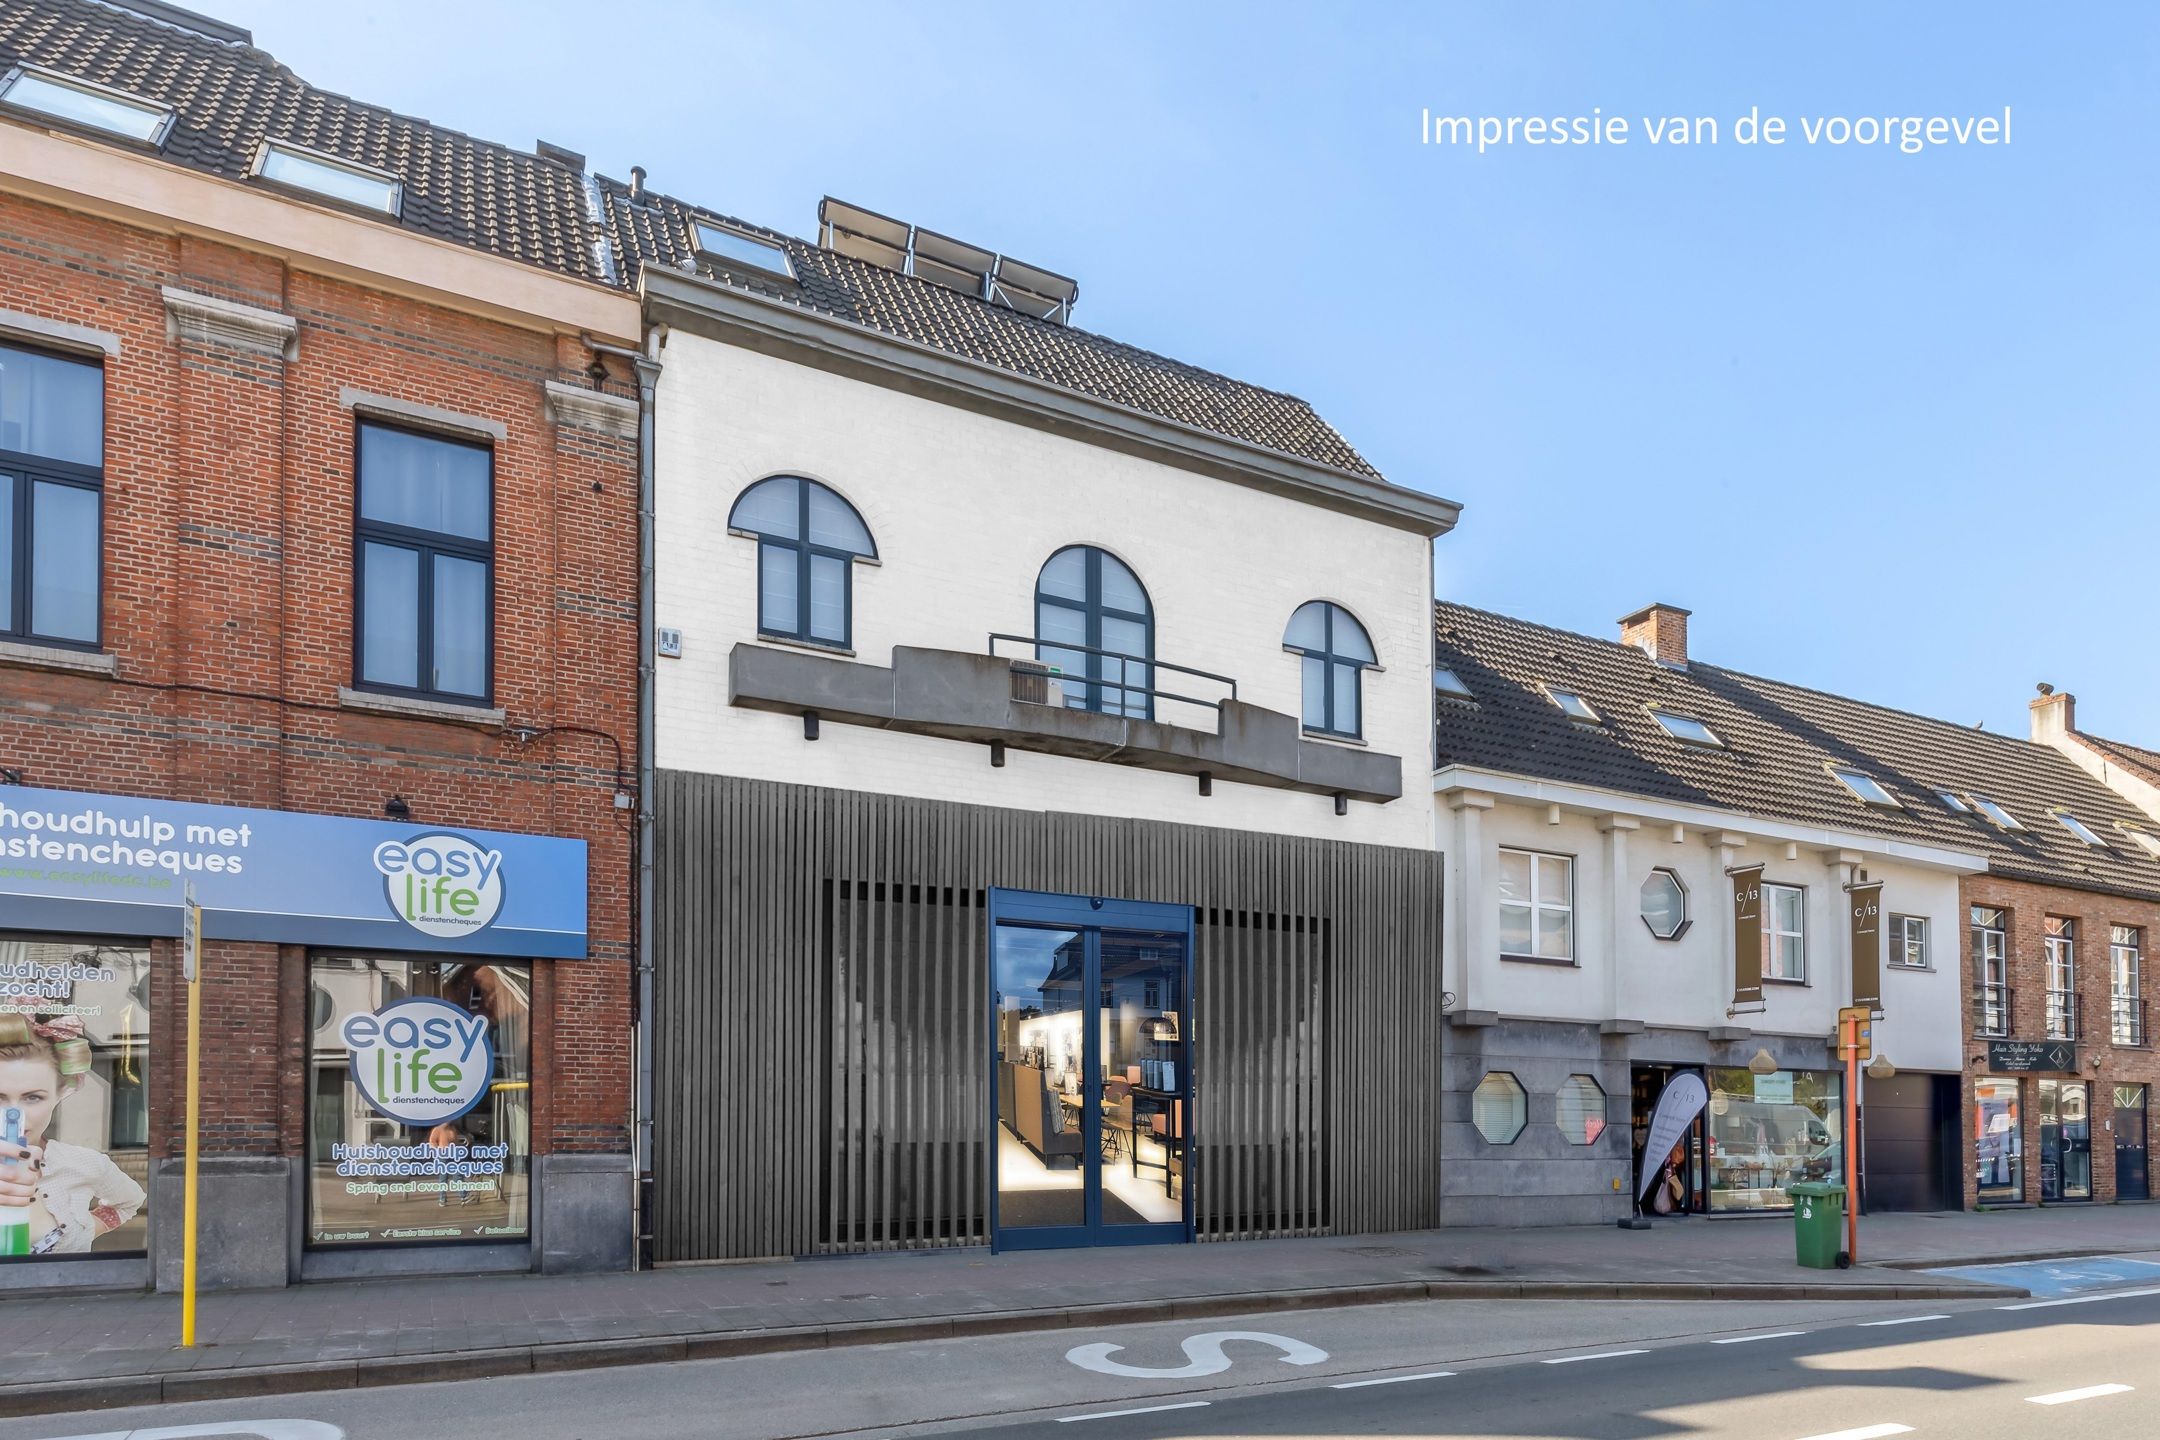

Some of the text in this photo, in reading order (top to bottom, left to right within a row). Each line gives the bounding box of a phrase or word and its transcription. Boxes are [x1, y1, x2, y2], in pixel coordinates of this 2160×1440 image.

[187, 823, 252, 847] met
[378, 844, 499, 890] easy
[406, 873, 480, 921] life
[418, 914, 482, 926] dienstencheques
[19, 1004, 36, 1014] en
[39, 1004, 102, 1015] solliciteer!
[343, 1015, 485, 1063] easy
[377, 1048, 463, 1104] life
[392, 1096, 466, 1106] dienstencheques
[332, 1143, 508, 1161] Huishoudhulp met
[336, 1159, 503, 1177] dienstencheques
[346, 1180, 495, 1196] Spring snel even binnen!
